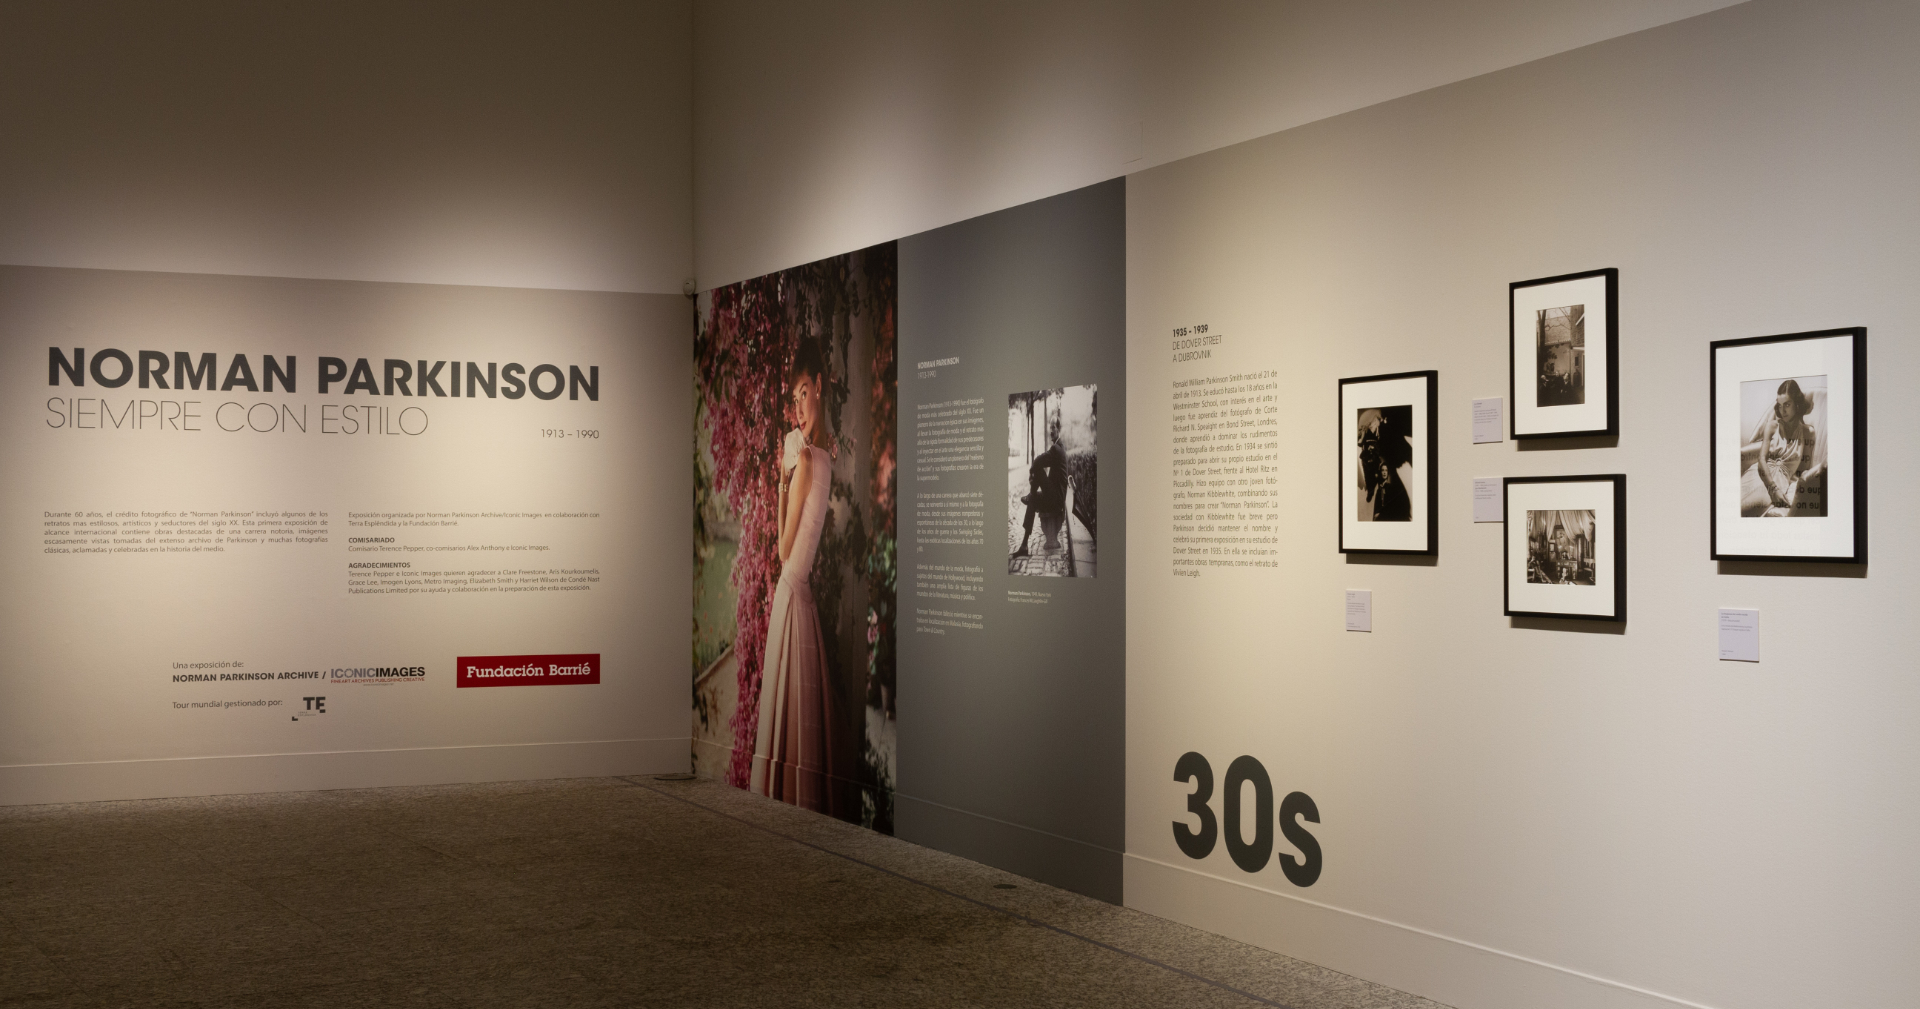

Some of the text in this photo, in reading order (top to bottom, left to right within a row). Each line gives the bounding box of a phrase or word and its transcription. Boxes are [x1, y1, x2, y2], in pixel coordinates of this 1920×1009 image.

[1172, 327, 1187, 337] 1935
[1193, 324, 1208, 335] 1939
[1172, 335, 1221, 351] DE DOVER STREET
[1172, 349, 1211, 363] A DUBROVNIK
[49, 347, 598, 401] NORMAN PARKINSON
[47, 397, 428, 435] SIEMPRE CON ESTILO
[541, 429, 564, 439] 1913
[576, 429, 599, 439] 1990
[190, 661, 230, 670] exposición
[467, 662, 591, 678] Fundación Barrié
[220, 672, 274, 681] PARKINSON
[277, 671, 319, 680] ARCHIVE
[322, 671, 326, 679] /
[331, 667, 425, 678] ICONICIMAGES
[192, 700, 222, 708] mundial
[224, 699, 266, 709] gestionado
[268, 700, 283, 708] por:
[1172, 752, 1322, 888] 30s
